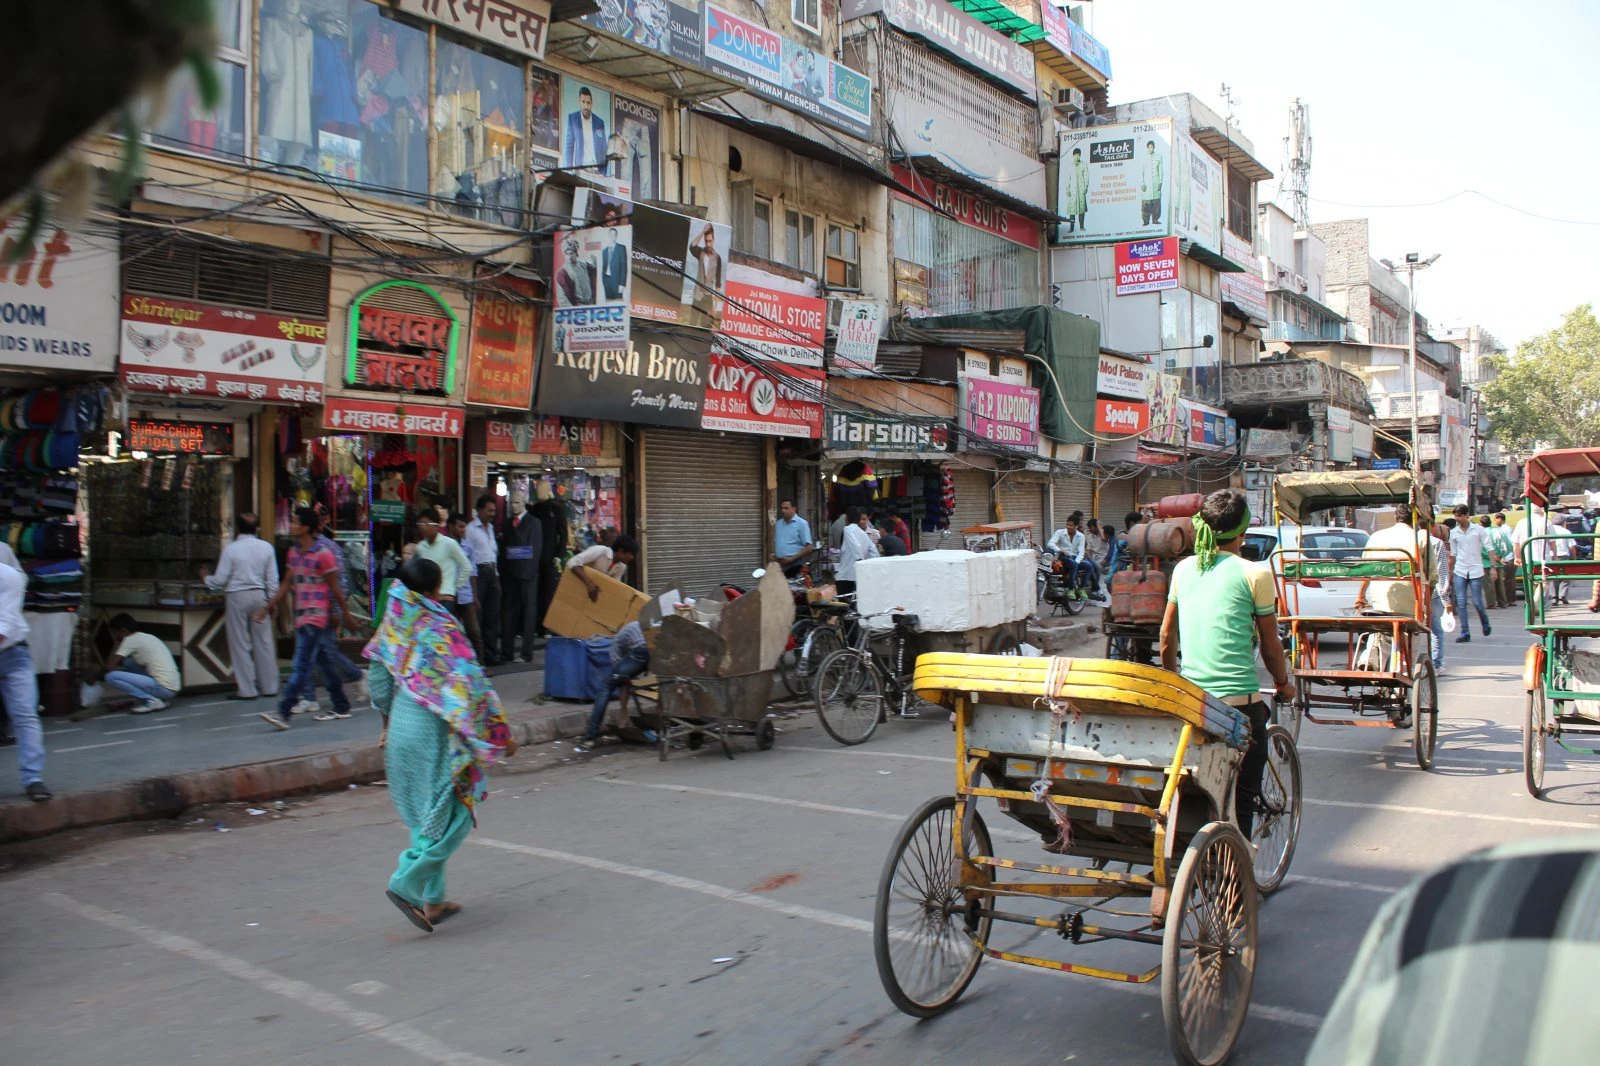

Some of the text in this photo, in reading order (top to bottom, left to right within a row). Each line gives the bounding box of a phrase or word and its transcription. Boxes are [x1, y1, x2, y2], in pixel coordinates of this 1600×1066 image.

[723, 19, 779, 67] DONEAR
[915, 0, 1009, 73] RAJU SUITS
[708, 45, 739, 63] SUITINGS
[747, 76, 783, 100] MARWAH
[784, 92, 820, 115] AGENCIES
[845, 74, 868, 98] Royal
[615, 97, 657, 122] ROOKIES
[1092, 142, 1133, 156] Ashok
[1104, 153, 1128, 161] TAILORS
[934, 183, 1008, 234] RAJU SUITS
[1130, 242, 1161, 255] Ashok
[1119, 258, 1175, 274] NOW SEVEN
[1121, 269, 1174, 284] DAYS OPEN
[0, 302, 46, 327] OOM
[125, 295, 205, 325] Shringar
[555, 305, 626, 325] महावर
[655, 307, 679, 320] BROS.
[727, 296, 822, 330] NATIONAL STORE
[360, 304, 452, 352] महावर
[765, 326, 812, 344] GARMENTS
[847, 318, 876, 333] HAJ
[840, 329, 877, 345] UMRAH
[32, 337, 92, 358] WEARS
[760, 343, 789, 356] Chowk
[646, 343, 702, 386] Bros.
[1100, 361, 1118, 376] Mod
[1119, 365, 1144, 381] Palace
[630, 389, 698, 411] Family Wears
[720, 397, 727, 413] &
[728, 398, 748, 415] Shirt
[978, 390, 1030, 424] G.P. KAPOOR
[344, 409, 448, 432] महावर ब्रादर्स
[702, 418, 717, 427] NEW
[718, 419, 748, 431] NATIONAL
[748, 423, 768, 433] STORE
[1105, 404, 1139, 429] Sparky
[131, 424, 204, 439] SUHAG CHURA
[489, 421, 597, 442] GRASIM ASIM
[832, 414, 930, 444] Harsons
[987, 424, 1022, 441] & SONS
[131, 437, 204, 450] BRIDAL SET
[542, 454, 574, 466] RAJESH
